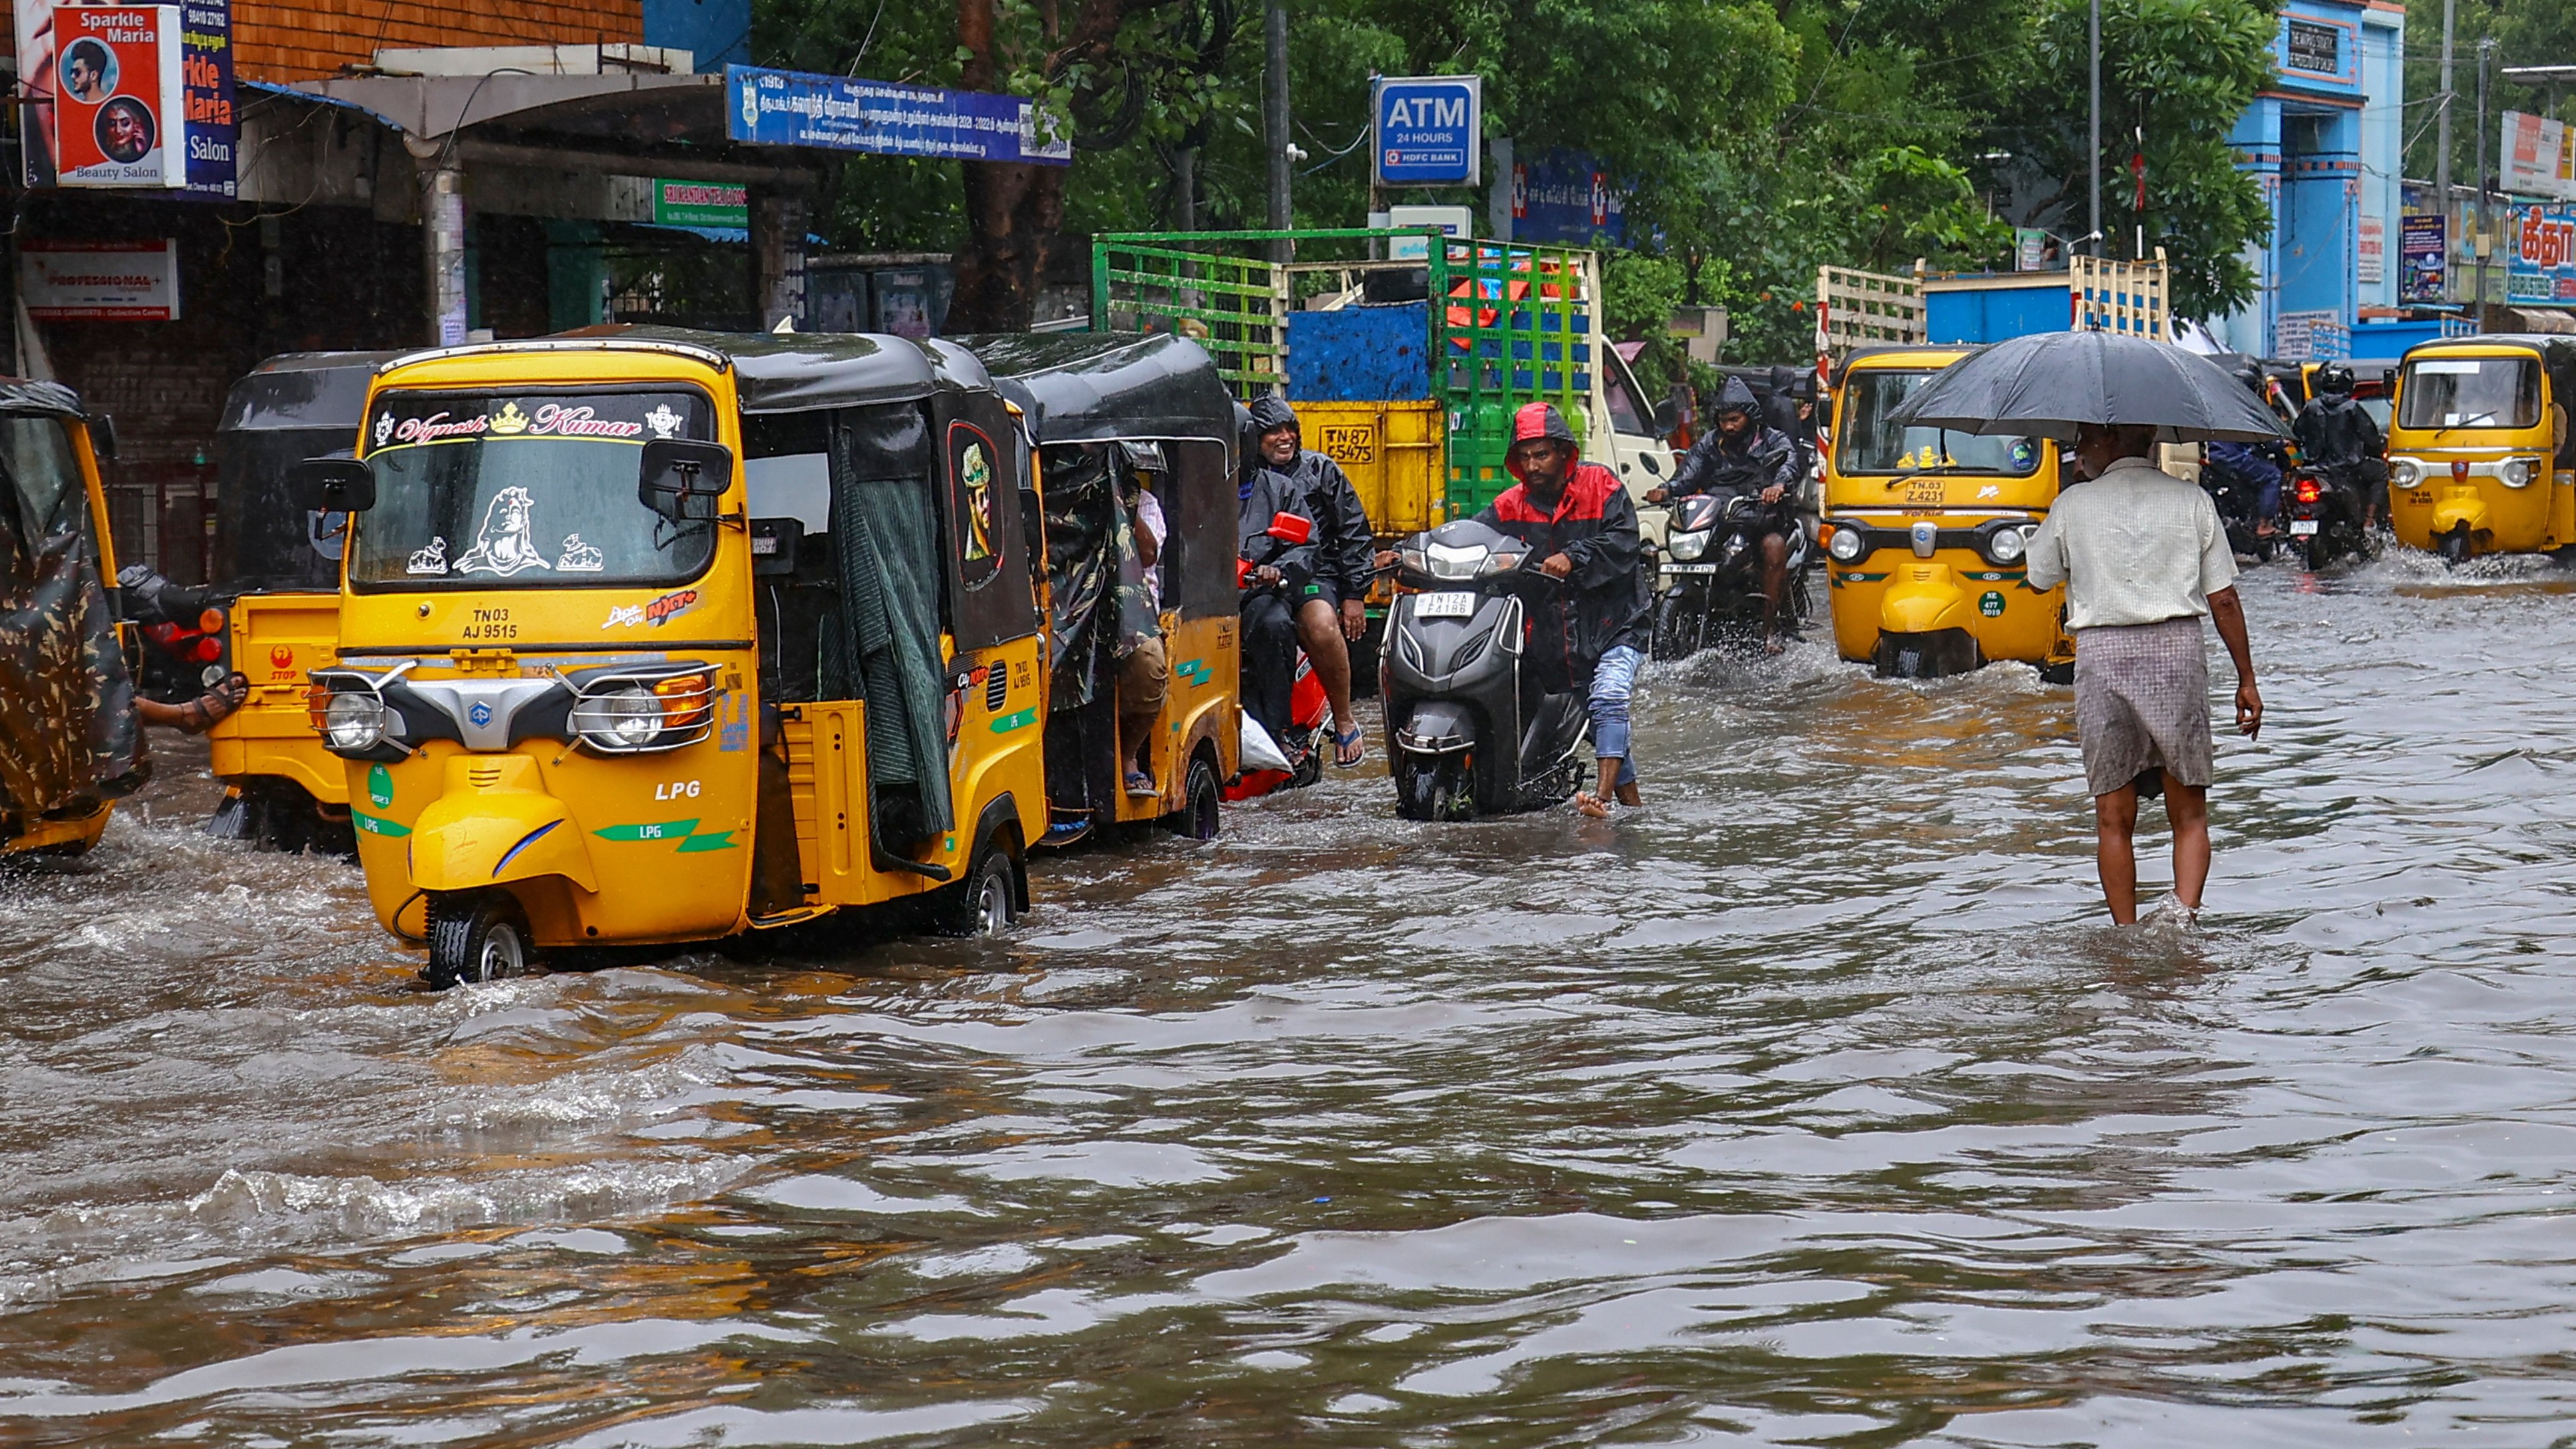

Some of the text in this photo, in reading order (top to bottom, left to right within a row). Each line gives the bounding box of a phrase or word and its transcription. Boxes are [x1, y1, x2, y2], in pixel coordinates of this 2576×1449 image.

[81, 12, 144, 31] Sparkle
[106, 28, 154, 43] Maria
[182, 54, 220, 89] rkle
[1387, 97, 1465, 128] ATM
[1397, 133, 1453, 143] 24 HOURS
[190, 135, 230, 161] Salon
[75, 166, 158, 180] Beauty Salon
[48, 276, 151, 286] PROFESSIONAL
[529, 404, 642, 436] Kumar
[395, 411, 489, 445] Vignesh
[1907, 491, 1943, 501] Z.4231
[462, 624, 517, 638] AJ 9515
[270, 670, 297, 680] STOP
[654, 781, 701, 801] LPG
[365, 817, 378, 833] LPG
[640, 824, 662, 839] LPG
